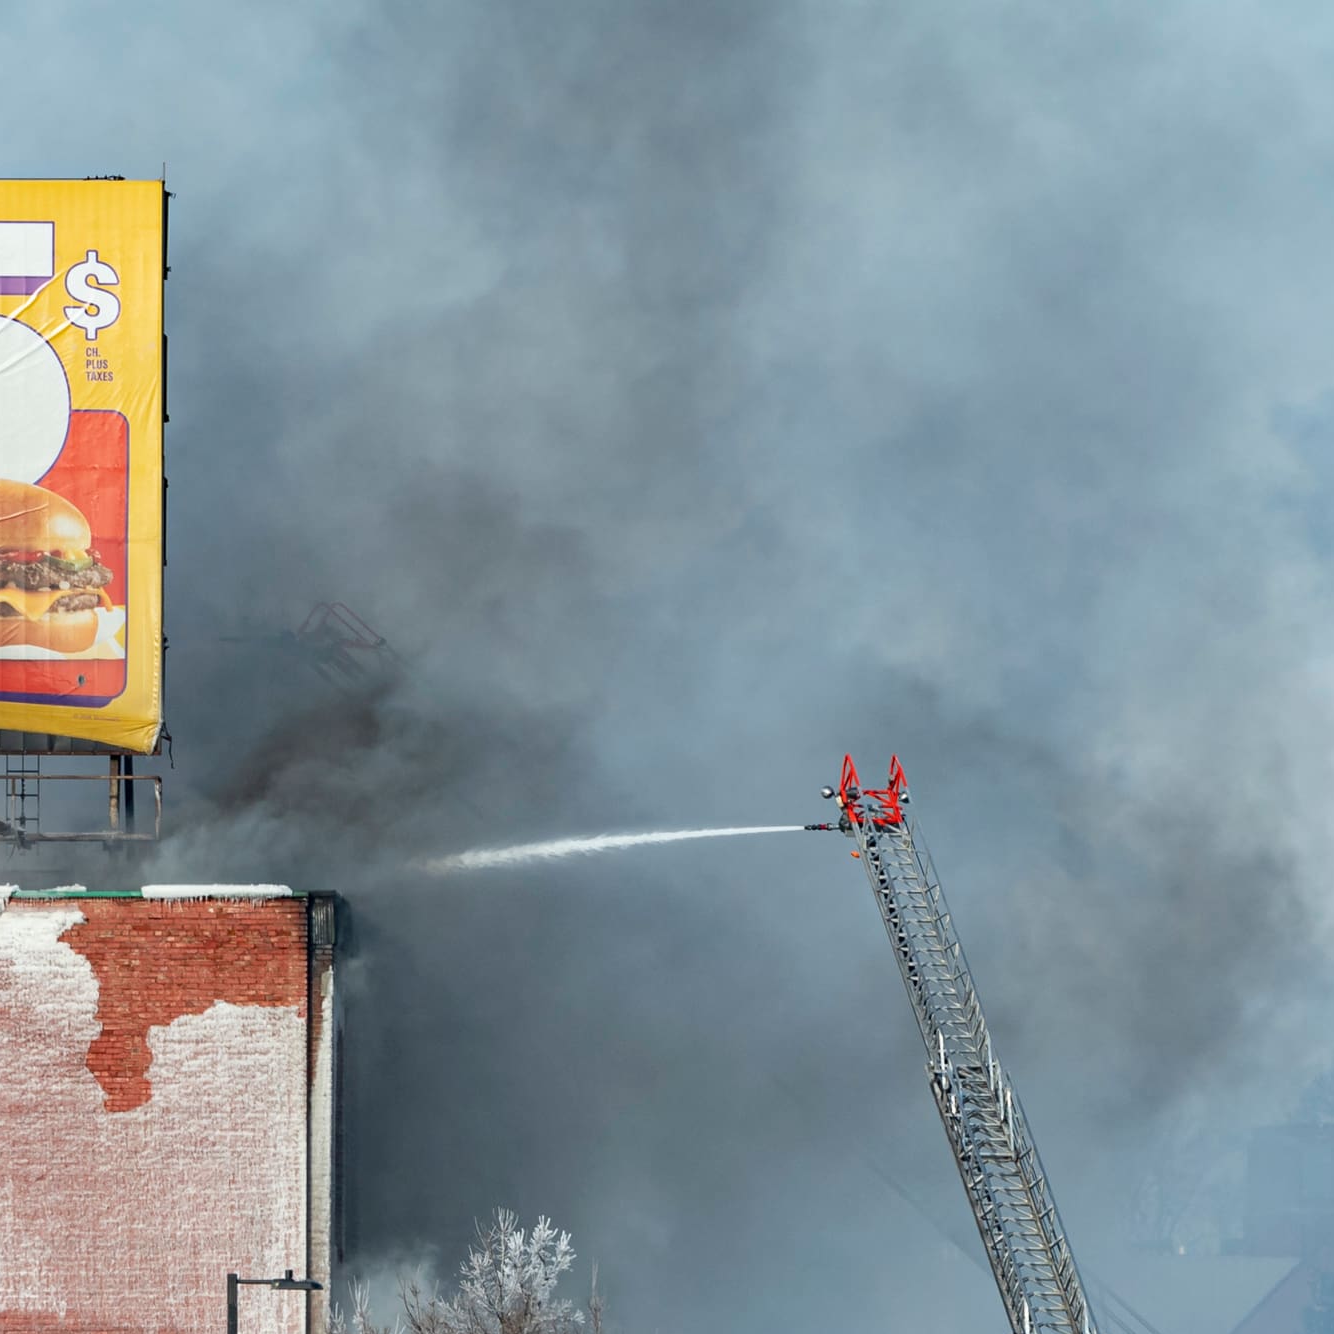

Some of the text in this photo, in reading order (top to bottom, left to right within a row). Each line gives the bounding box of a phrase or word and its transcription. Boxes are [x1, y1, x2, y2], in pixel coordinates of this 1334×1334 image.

[63, 249, 121, 341] $
[85, 347, 101, 357] CH.
[85, 359, 109, 370] PLUS
[85, 371, 114, 382] TAXES
